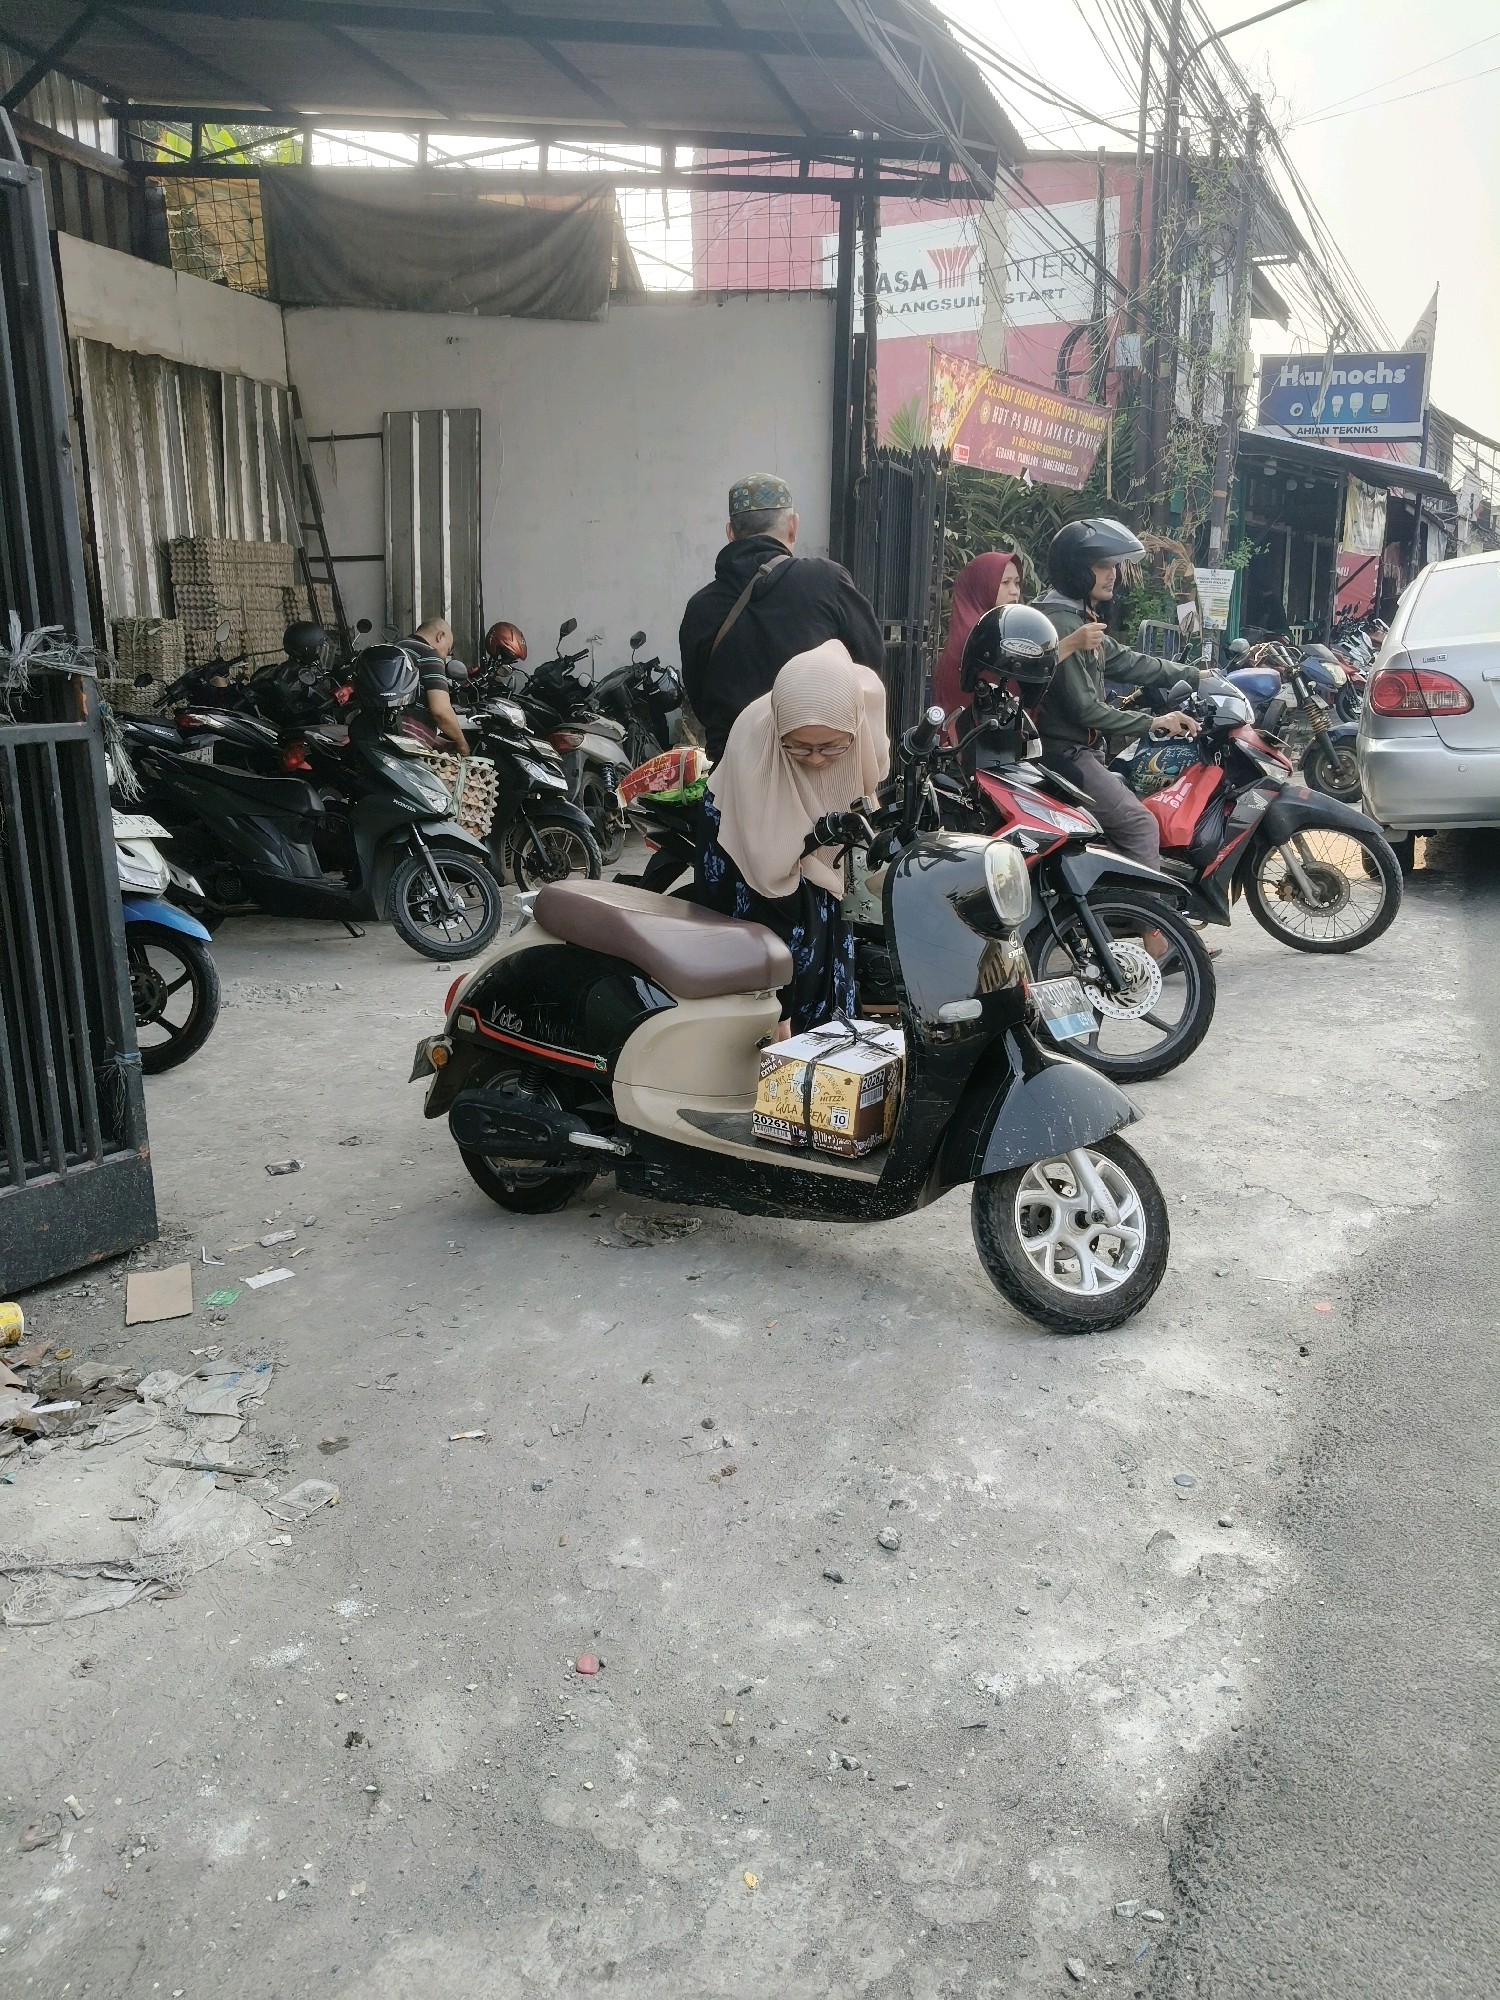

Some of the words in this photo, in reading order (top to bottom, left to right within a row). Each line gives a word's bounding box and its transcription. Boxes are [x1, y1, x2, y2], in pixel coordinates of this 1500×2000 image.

[858, 269, 928, 295] ASA
[979, 251, 1091, 285] TTERY
[889, 296, 985, 314] LANGSUN
[1003, 287, 1067, 304] START
[1279, 361, 1406, 387] Hannochs
[985, 378, 1016, 402] SELAMAT
[1013, 388, 1039, 411] DATANG
[1036, 396, 1063, 419] PESERTA
[1061, 404, 1078, 423] OPEN
[991, 405, 1010, 425] HUT
[1009, 411, 1022, 430] PS
[1022, 415, 1043, 435] BINA
[1043, 421, 1063, 441] JAYA
[1063, 427, 1075, 444] KE
[1296, 426, 1330, 435] AHIAN
[1332, 425, 1379, 435] TEKNIK3
[392, 798, 417, 813] HONDA
[490, 1000, 523, 1033] Vito
[760, 1062, 778, 1078] EXTRA
[753, 1113, 789, 1130] 20262
[775, 1101, 798, 1115] GULA
[800, 1108, 827, 1124] EN
[833, 1114, 846, 1125] 10
